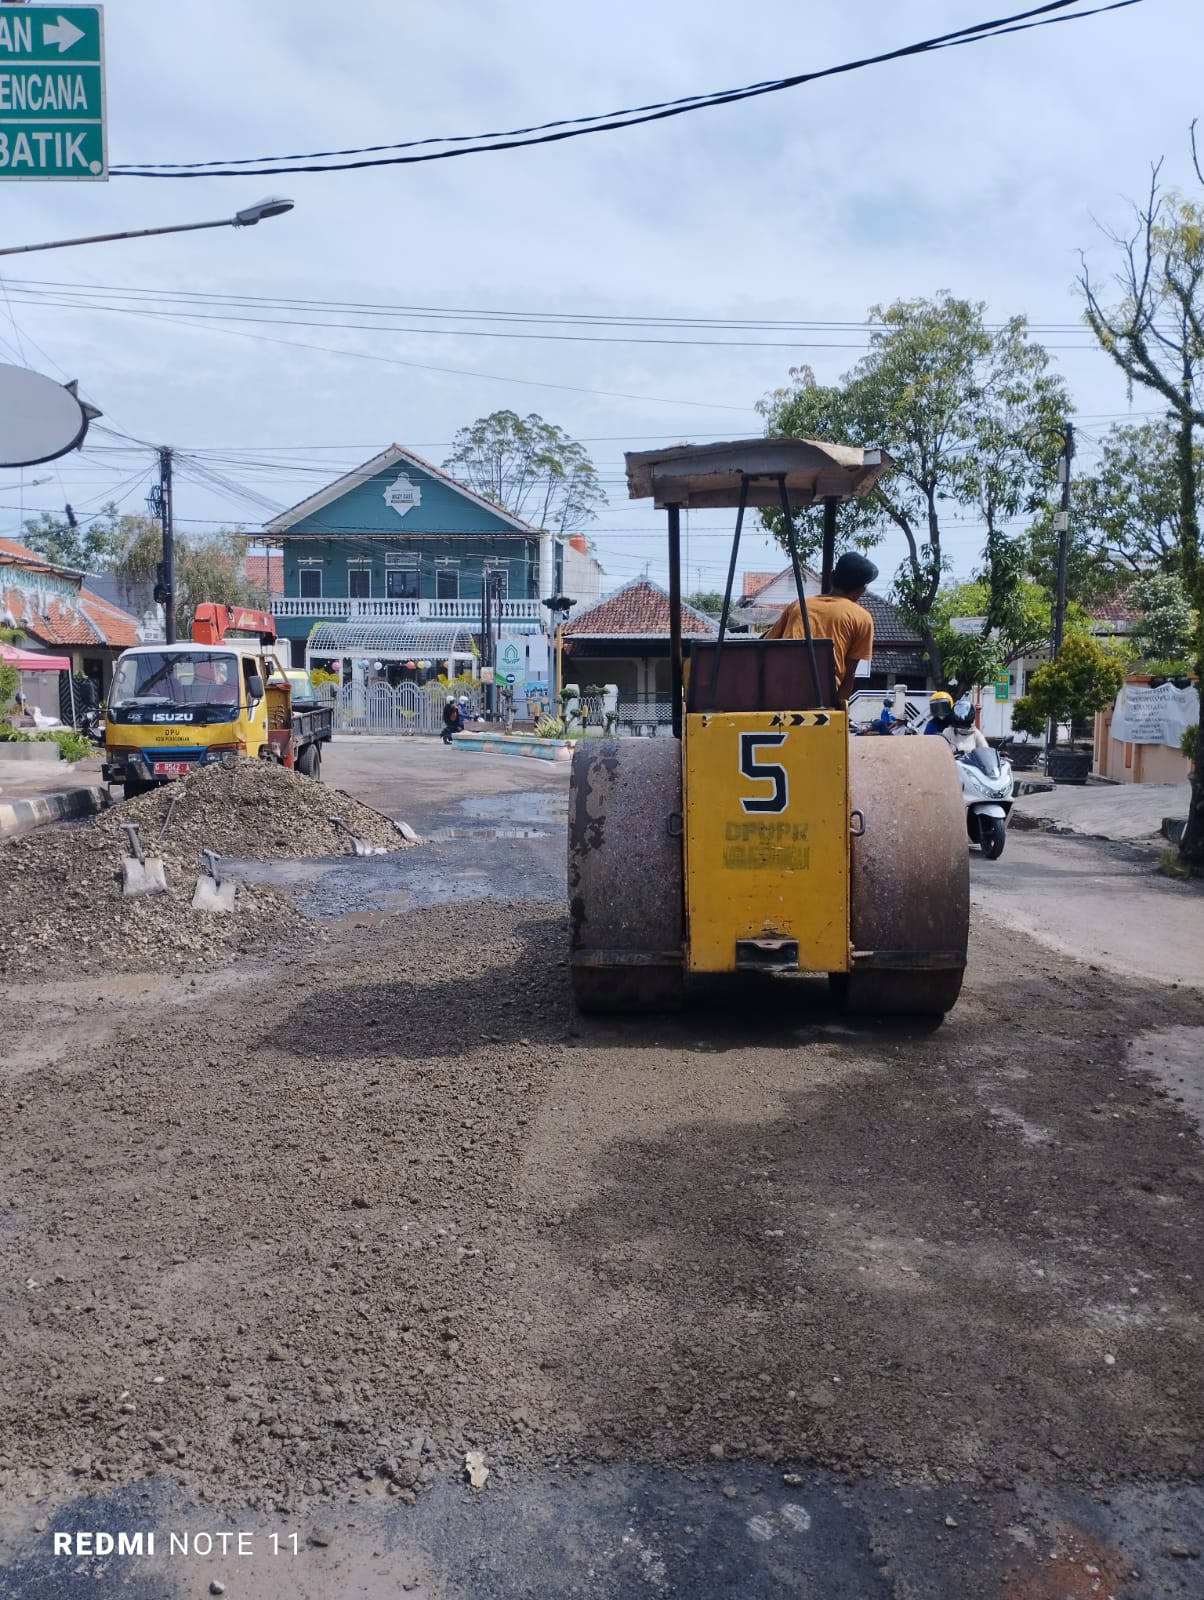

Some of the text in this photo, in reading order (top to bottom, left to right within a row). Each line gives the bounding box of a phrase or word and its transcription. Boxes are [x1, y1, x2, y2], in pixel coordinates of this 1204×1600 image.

[0, 74, 88, 110] ENCANA
[152, 713, 193, 722] ISUZU
[739, 731, 789, 814] 5
